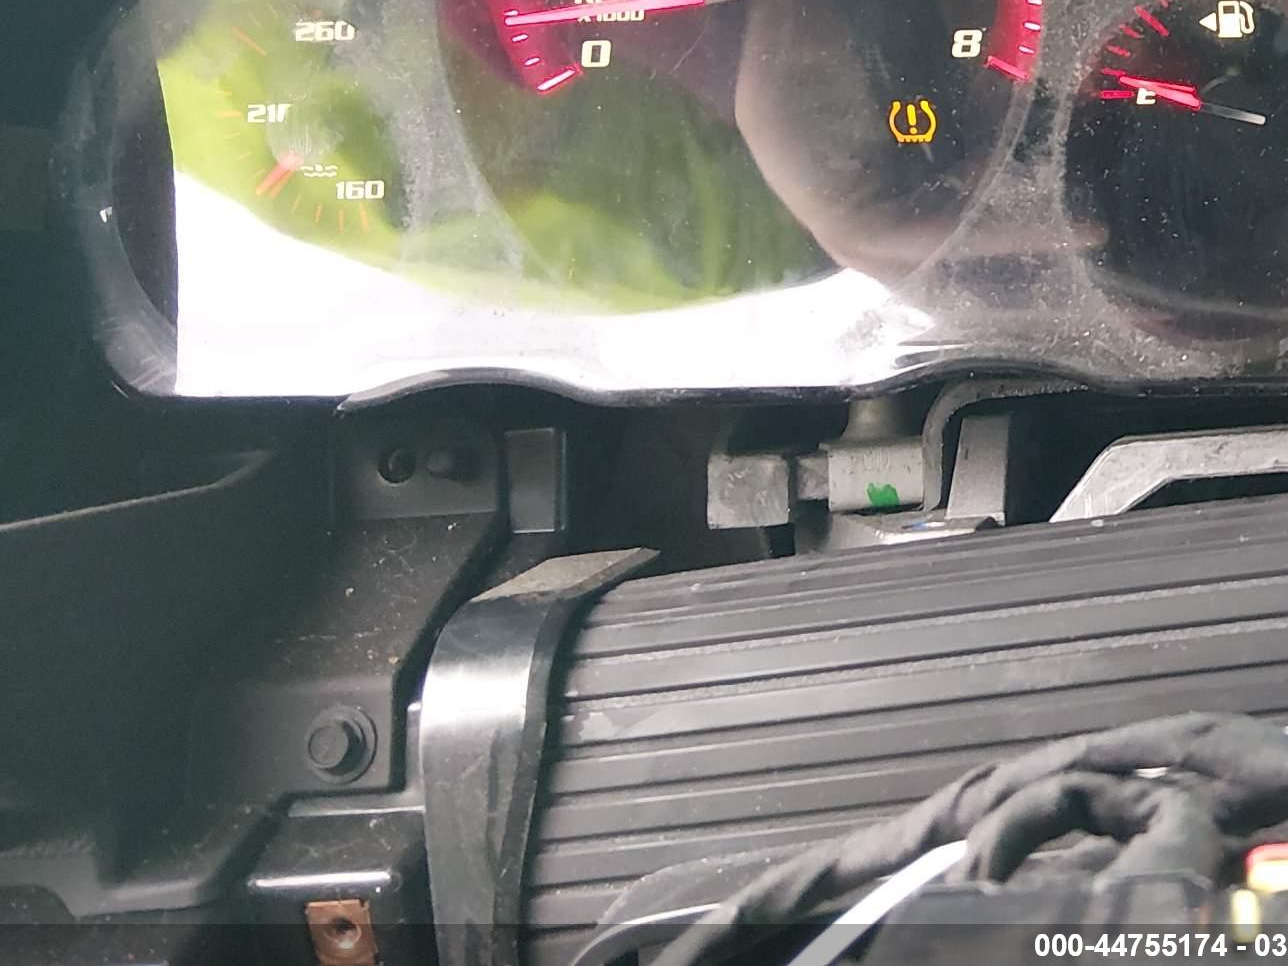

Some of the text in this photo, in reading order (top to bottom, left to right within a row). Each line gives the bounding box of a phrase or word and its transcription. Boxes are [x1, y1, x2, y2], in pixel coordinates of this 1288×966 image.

[294, 20, 356, 42] 260
[951, 28, 983, 59] 8
[581, 39, 613, 68] 0
[335, 180, 385, 200] 160
